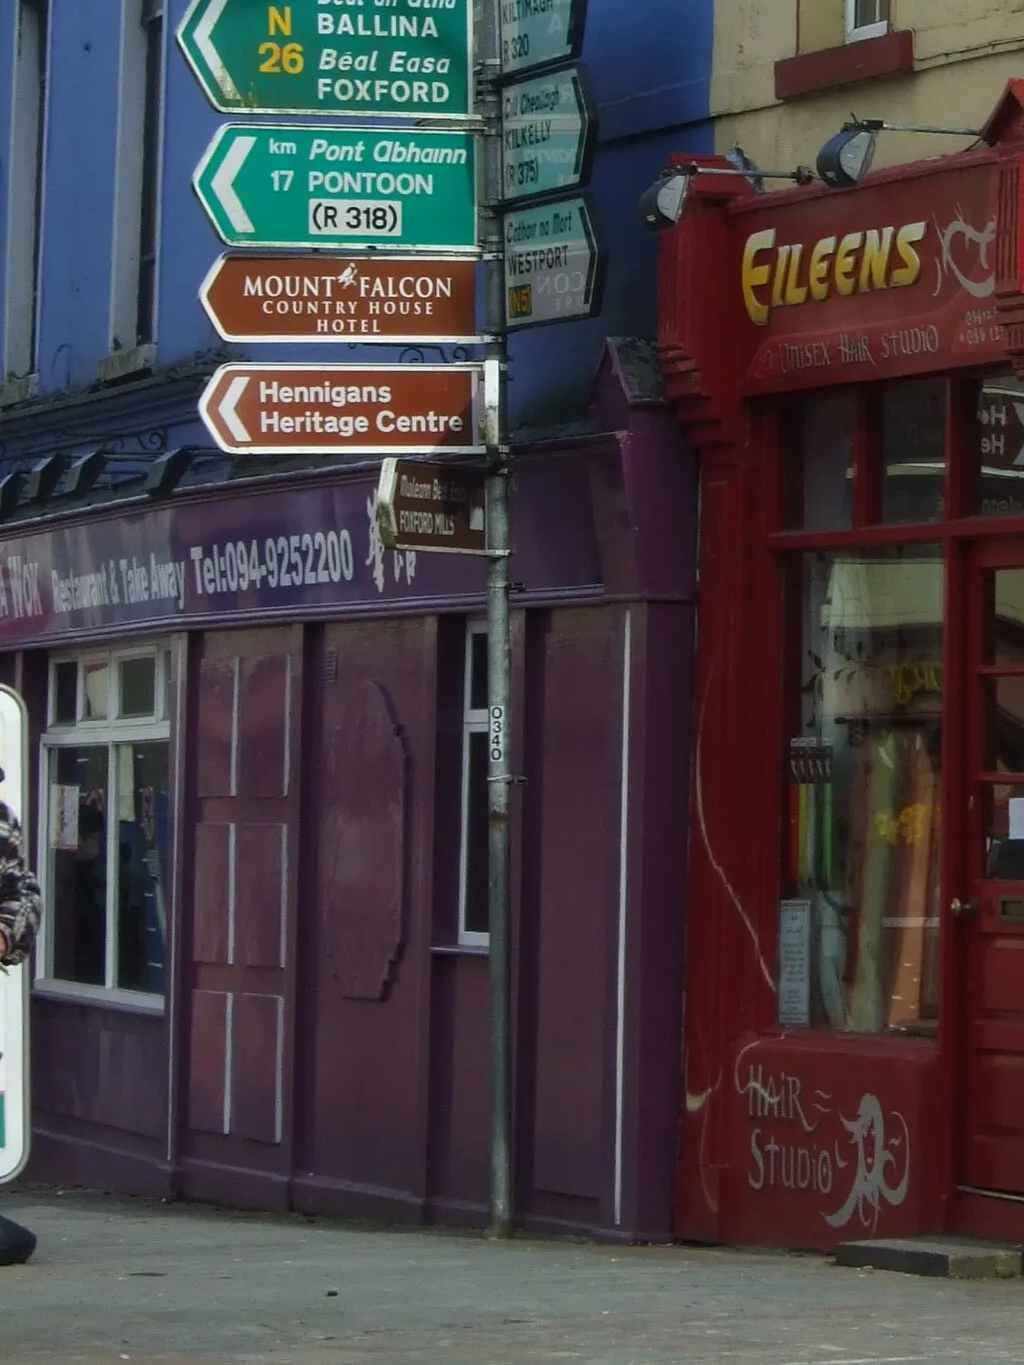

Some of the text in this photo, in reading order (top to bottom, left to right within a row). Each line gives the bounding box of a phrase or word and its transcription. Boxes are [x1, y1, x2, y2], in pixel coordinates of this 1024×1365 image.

[268, 6, 292, 36] N
[317, 13, 439, 38] BALLINA
[258, 42, 304, 74] 26
[318, 48, 451, 74] Béal Easa
[503, 33, 530, 63] R 320
[317, 78, 450, 103] FOXFORD
[504, 119, 552, 152] KILKELLY
[269, 138, 468, 165] km Pont Abhainn
[270, 170, 434, 195] 17 PONTOON
[517, 156, 539, 186] 375)
[312, 202, 398, 232] (R 318)
[506, 245, 569, 276] WESTPORT
[742, 221, 927, 326] EILEENS
[243, 274, 453, 298] MOUNT FALCON
[262, 300, 434, 315] COUNTRY HOUSE
[317, 318, 381, 333] HOTEL
[259, 381, 392, 407] Hennigans
[259, 410, 464, 437] Heritage Centre
[400, 510, 455, 535] FOXFORD MILLS
[109, 558, 120, 605] &
[120, 556, 149, 605] Take
[150, 553, 186, 610] Away
[190, 529, 354, 595] Tel:094-9252200
[491, 707, 503, 761] 0340
